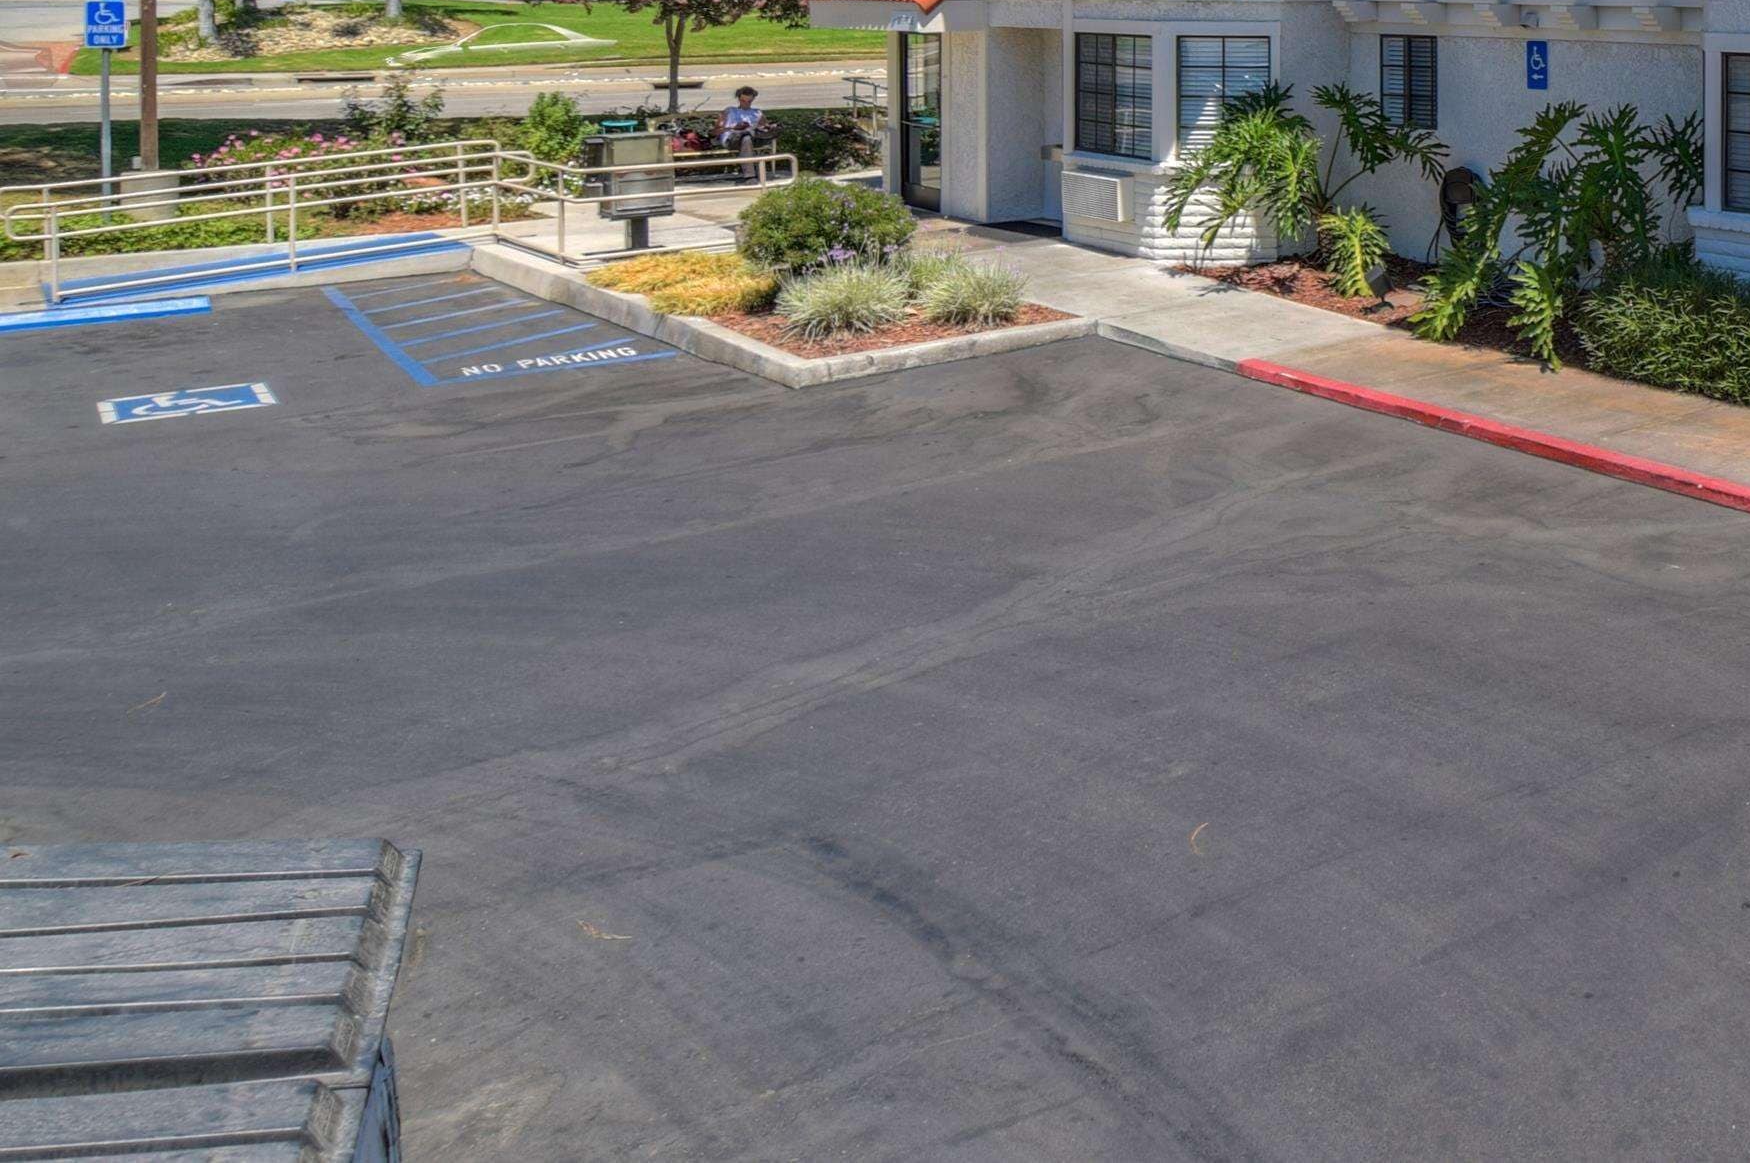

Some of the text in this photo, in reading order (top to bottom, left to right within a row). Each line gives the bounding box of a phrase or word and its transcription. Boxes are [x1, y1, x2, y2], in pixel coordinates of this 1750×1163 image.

[93, 34, 119, 45] ONLY
[459, 346, 638, 377] NO PARKING
